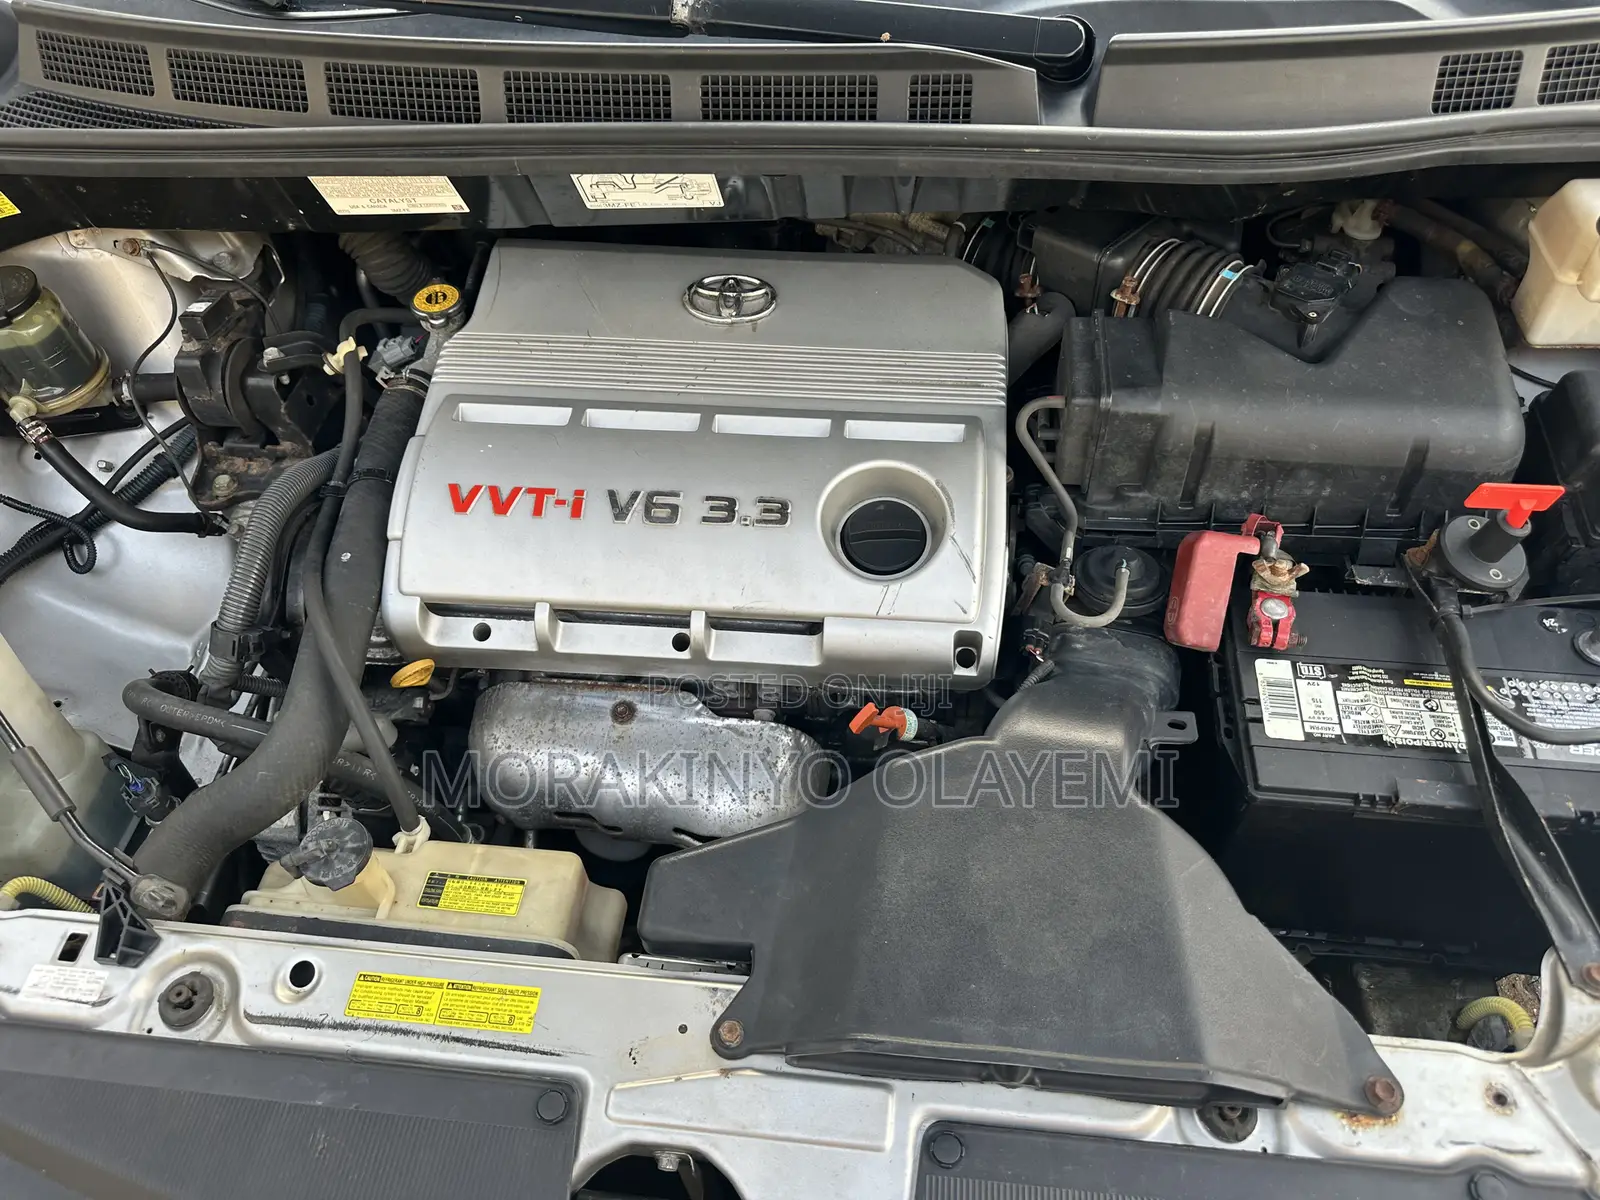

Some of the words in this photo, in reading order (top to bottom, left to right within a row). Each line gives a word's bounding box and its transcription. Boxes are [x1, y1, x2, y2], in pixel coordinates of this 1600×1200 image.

[448, 483, 587, 520] VVT-i
[607, 489, 684, 526] V6
[700, 495, 792, 528] 3.3
[1382, 734, 1466, 750] DANGER/POISON
